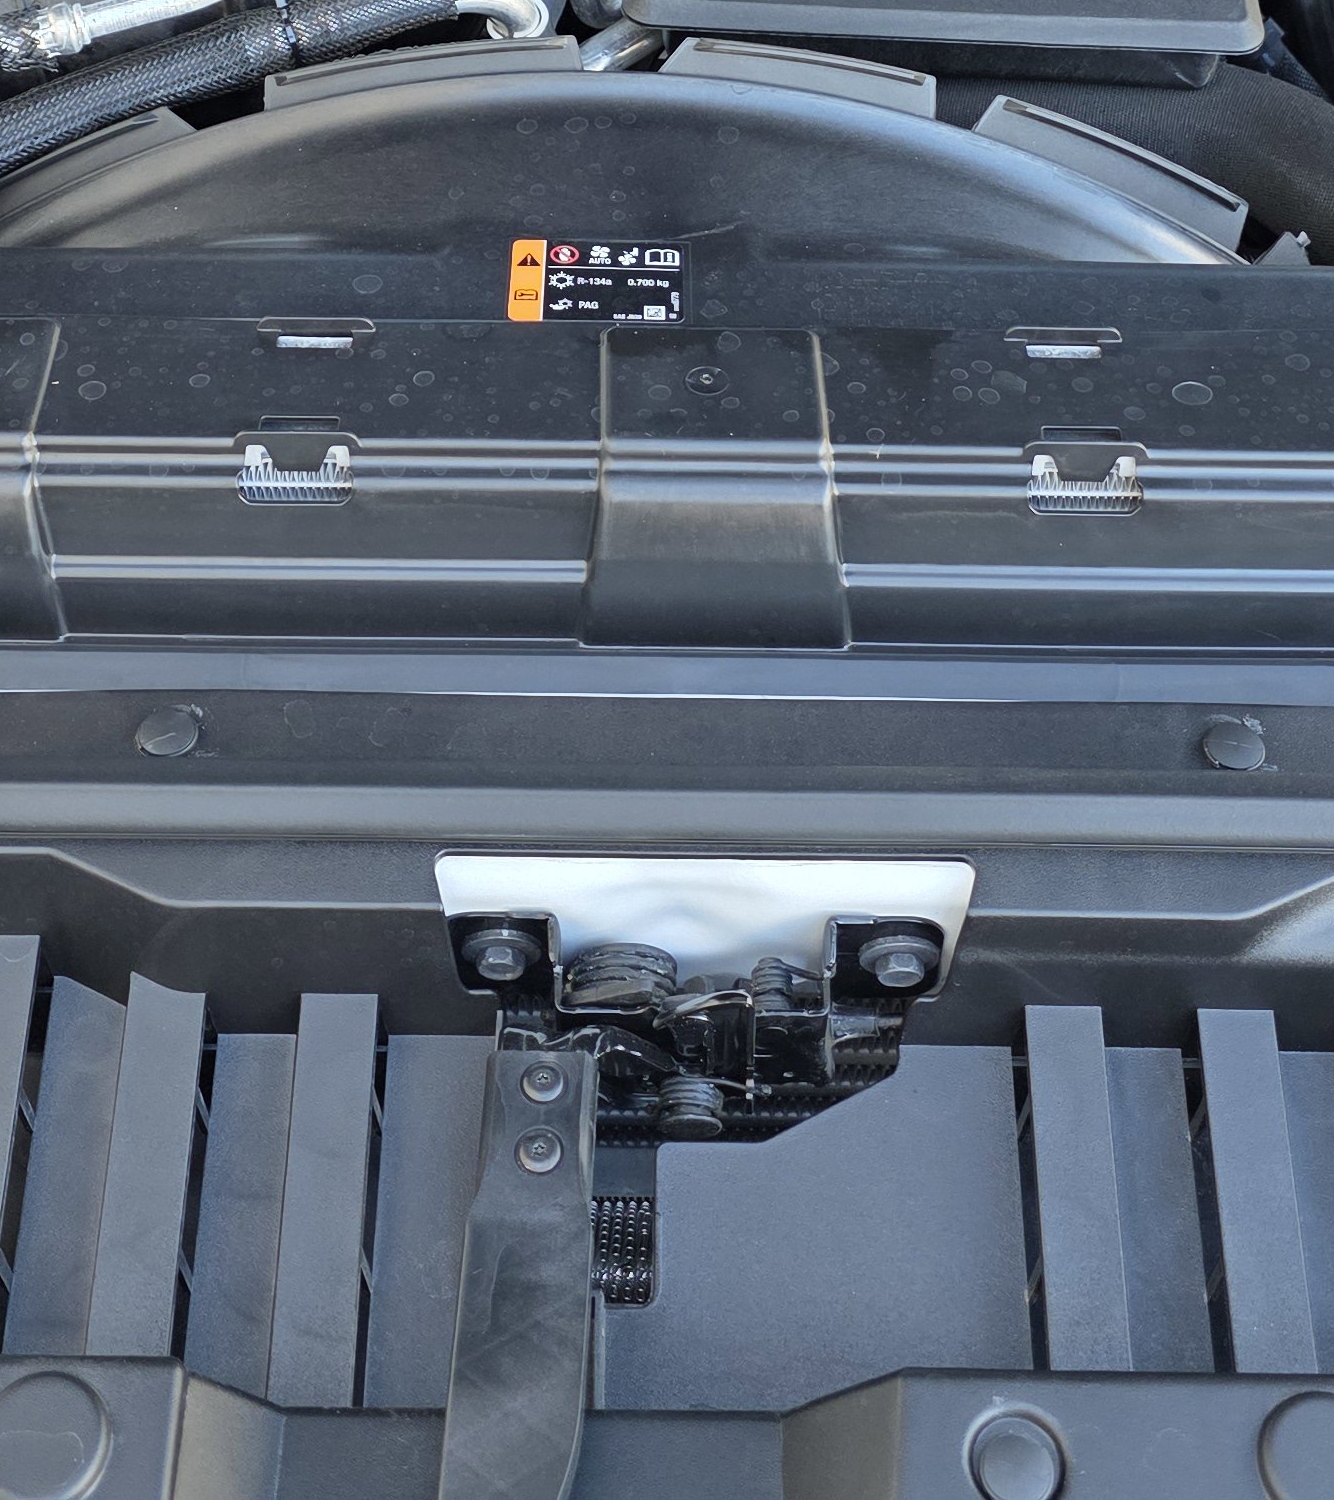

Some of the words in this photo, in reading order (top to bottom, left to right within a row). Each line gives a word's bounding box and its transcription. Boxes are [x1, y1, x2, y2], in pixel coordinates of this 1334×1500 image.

[588, 257, 612, 265] AUTO
[577, 277, 613, 286] R-134a
[627, 278, 655, 287] 0.700
[656, 279, 670, 288] kg
[578, 301, 599, 309] PAG
